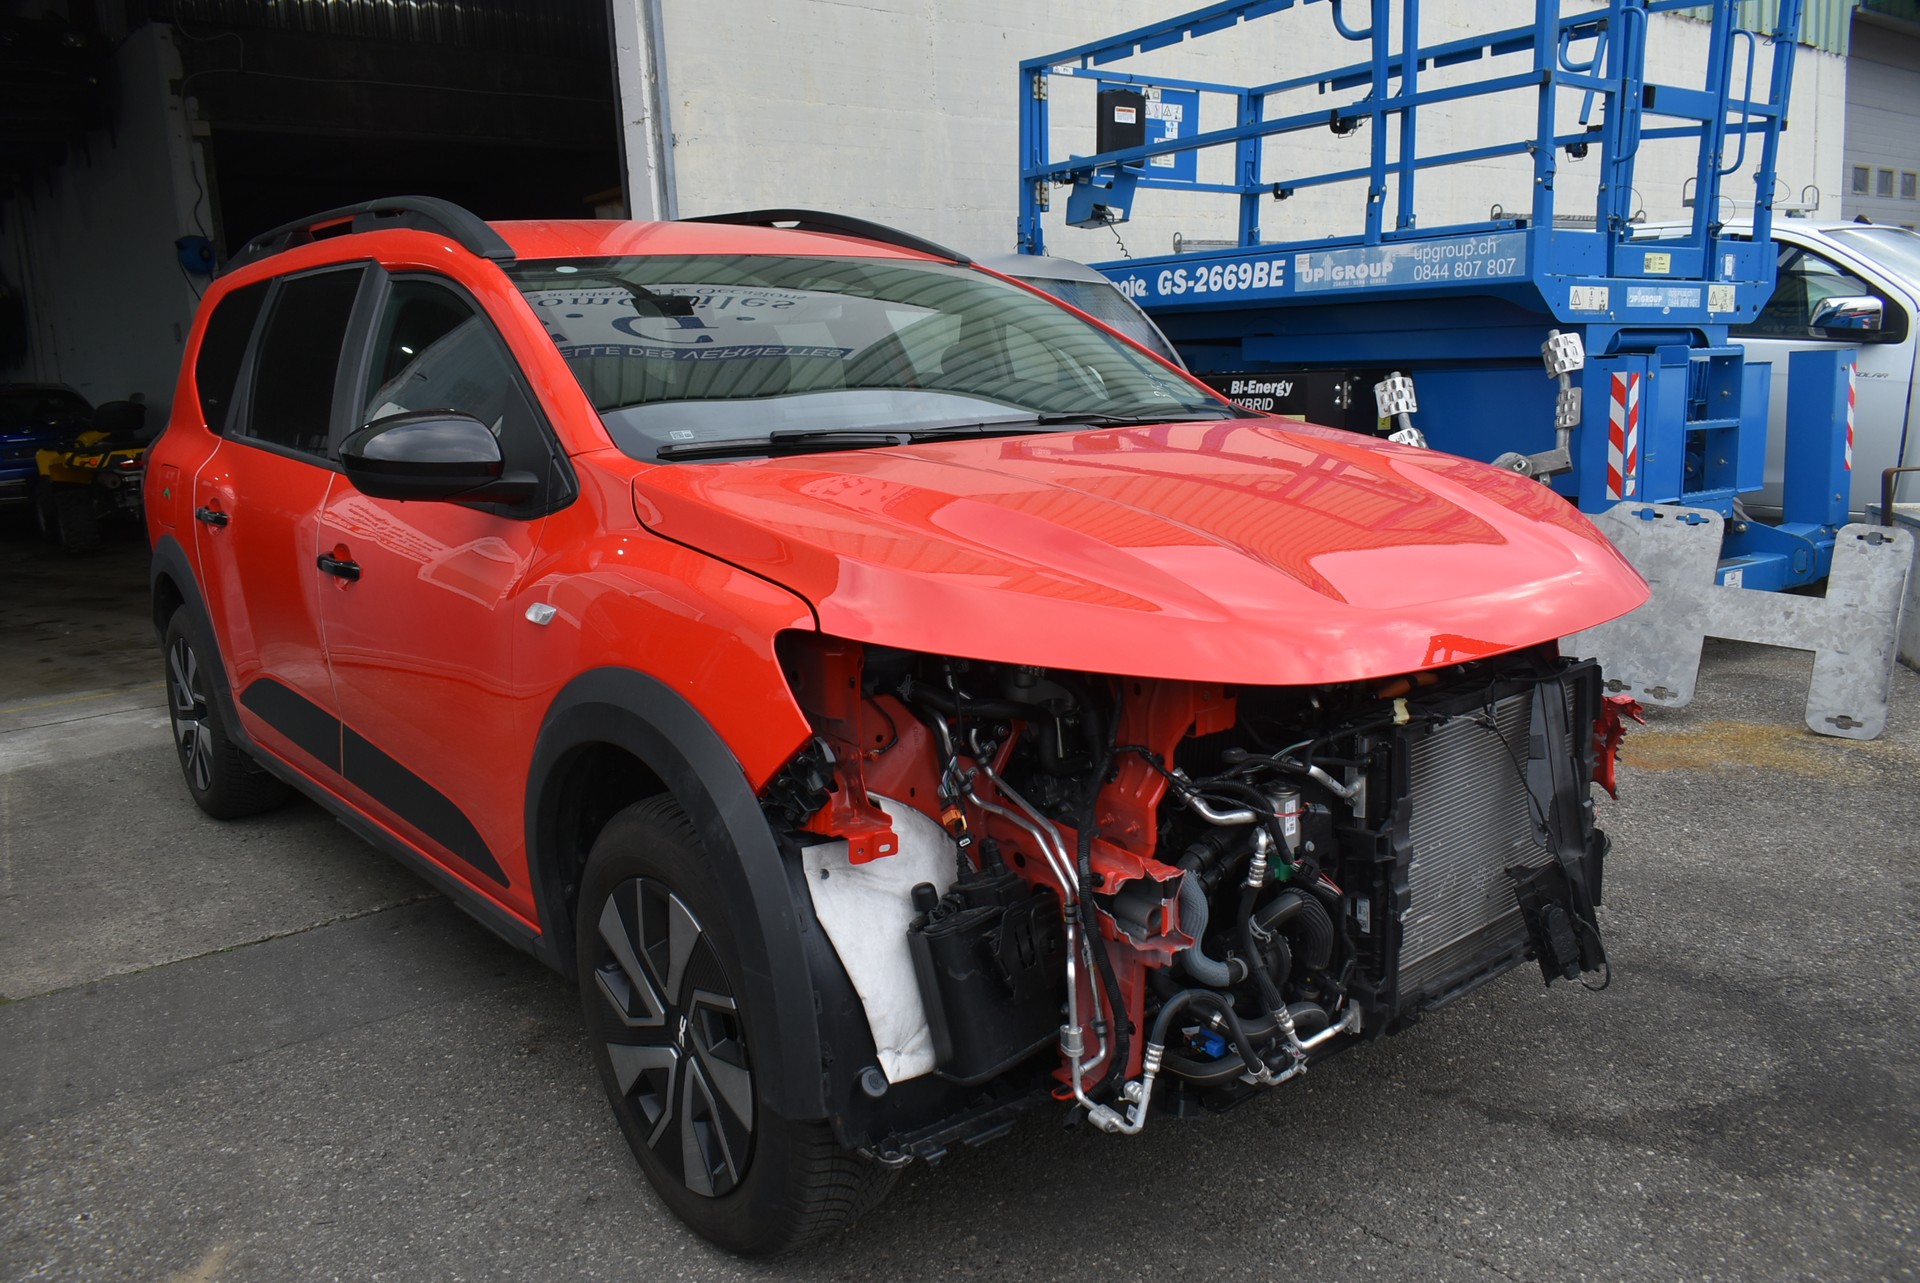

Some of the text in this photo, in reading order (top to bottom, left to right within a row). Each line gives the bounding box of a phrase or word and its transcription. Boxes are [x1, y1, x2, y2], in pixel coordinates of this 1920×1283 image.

[1413, 240, 1497, 262] upgroup.ch
[1111, 260, 1287, 297] nie GS-2669BE
[1413, 258, 1517, 281] 0844 807 807
[1230, 380, 1293, 397] Bi-Energy
